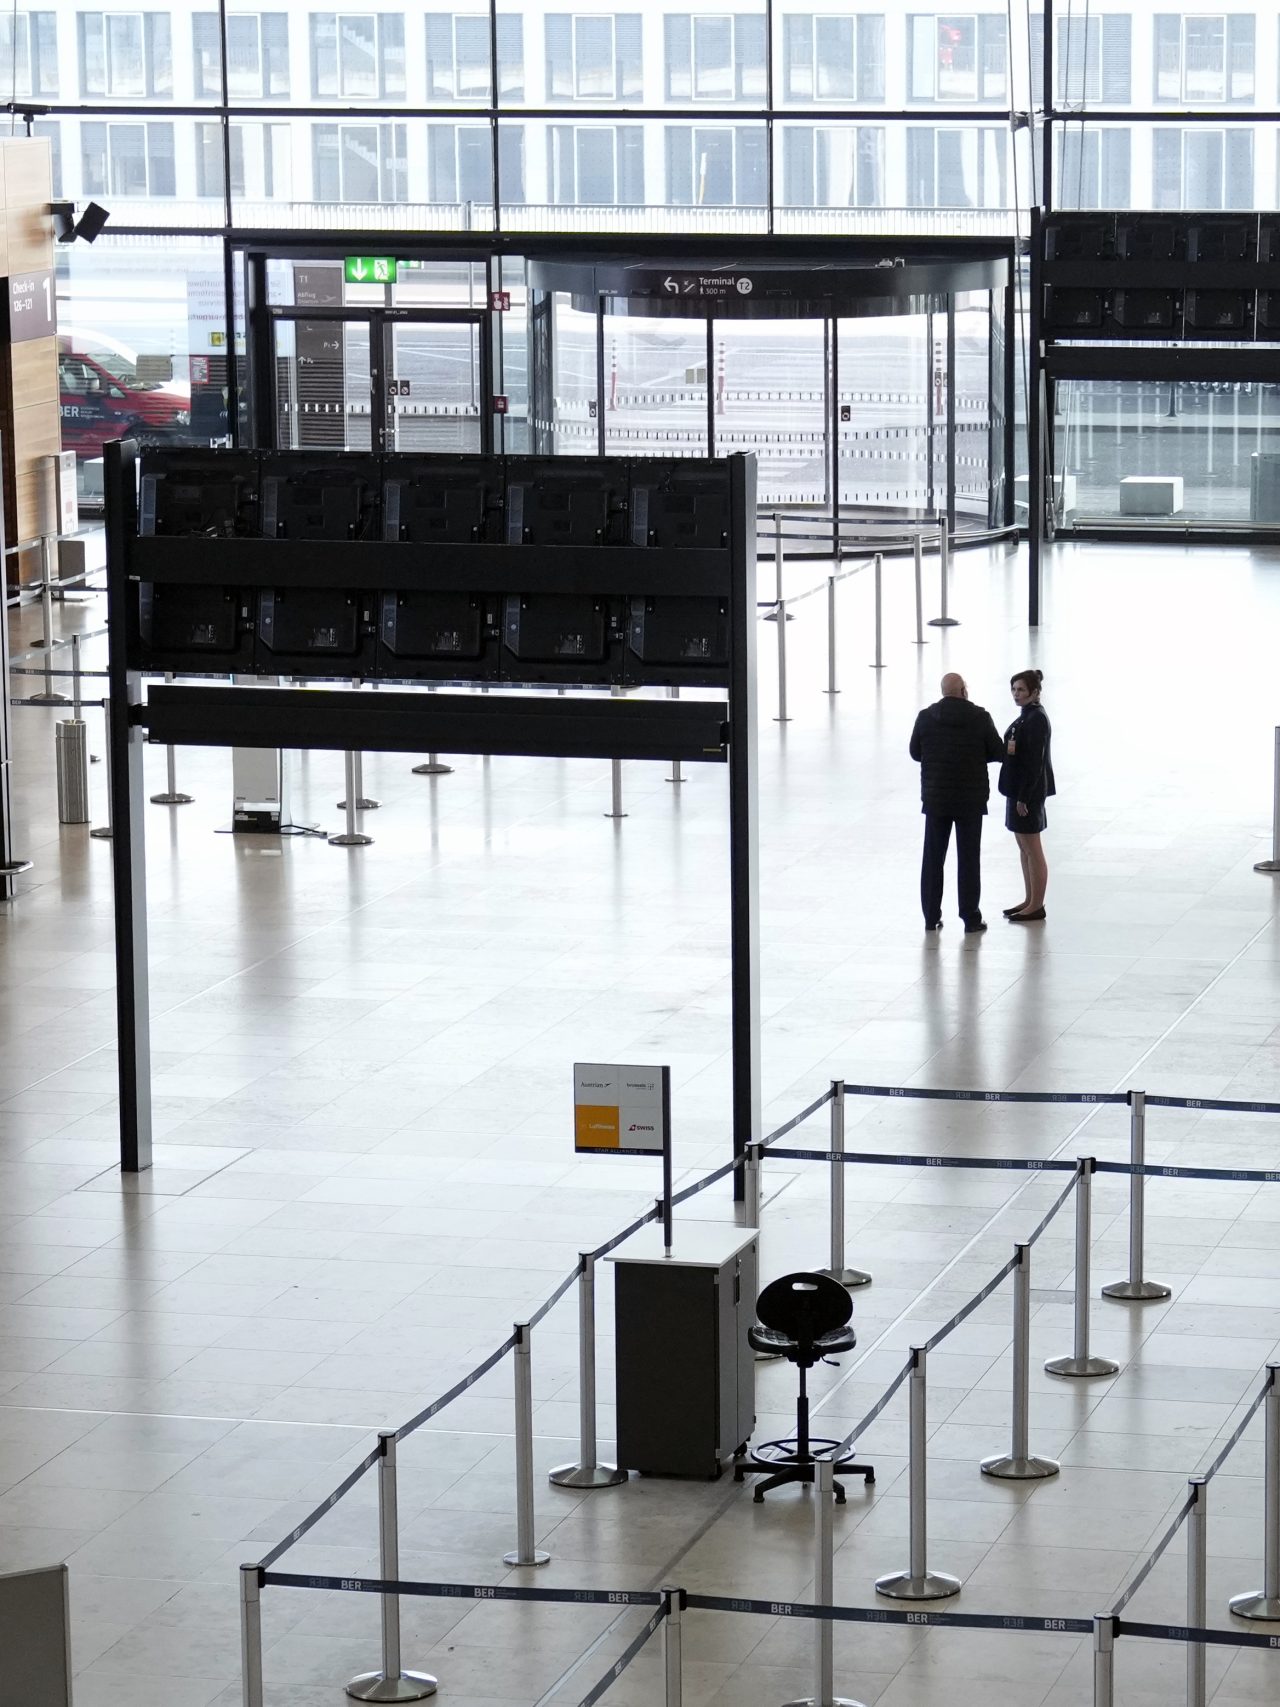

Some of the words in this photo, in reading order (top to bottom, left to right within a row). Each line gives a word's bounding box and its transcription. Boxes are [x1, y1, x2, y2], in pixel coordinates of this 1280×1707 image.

[699, 277, 735, 285] Terminal
[12, 280, 34, 295] Check-in
[739, 282, 750, 290] T2
[42, 277, 52, 321] 1
[985, 1093, 1000, 1101] BER
[1186, 1100, 1201, 1108] BER
[926, 1158, 942, 1166] BER
[1027, 1161, 1043, 1169] BER
[1163, 1168, 1178, 1176] BER
[1265, 1173, 1280, 1181] BER
[341, 1580, 361, 1590] BER
[474, 1588, 495, 1598] BER
[608, 1592, 629, 1603] BER
[770, 1603, 792, 1614] BER
[907, 1613, 928, 1624] BER
[1044, 1619, 1065, 1630] BER
